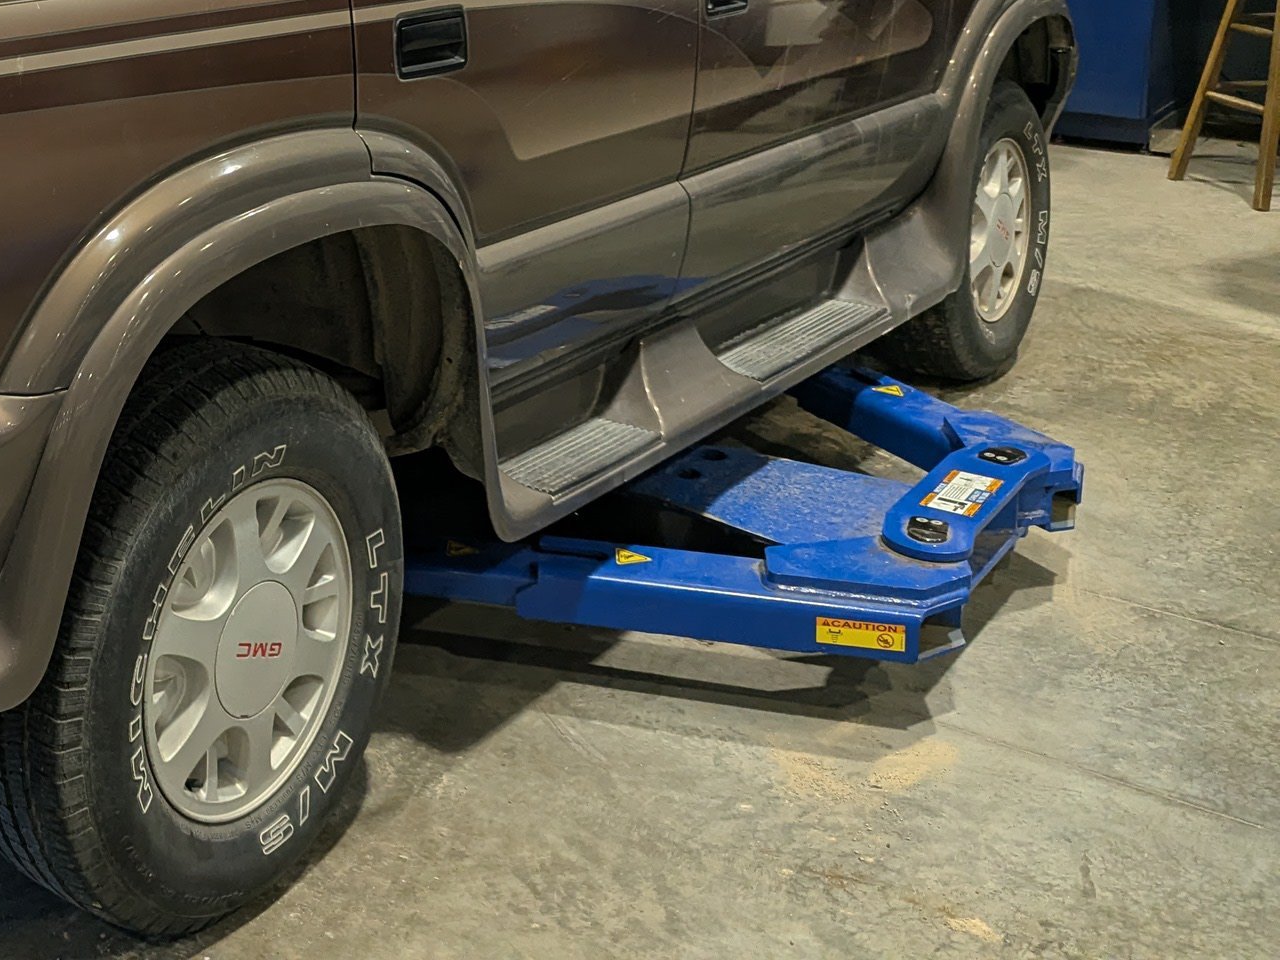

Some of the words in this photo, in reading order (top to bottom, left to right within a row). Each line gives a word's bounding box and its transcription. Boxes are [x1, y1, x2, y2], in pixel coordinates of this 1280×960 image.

[1022, 121, 1048, 183] LTX
[129, 444, 287, 814] MICHELIN
[235, 641, 283, 659] GMC
[359, 527, 389, 679] LTX
[830, 620, 898, 633] CAUTION
[259, 730, 354, 856] M/S
